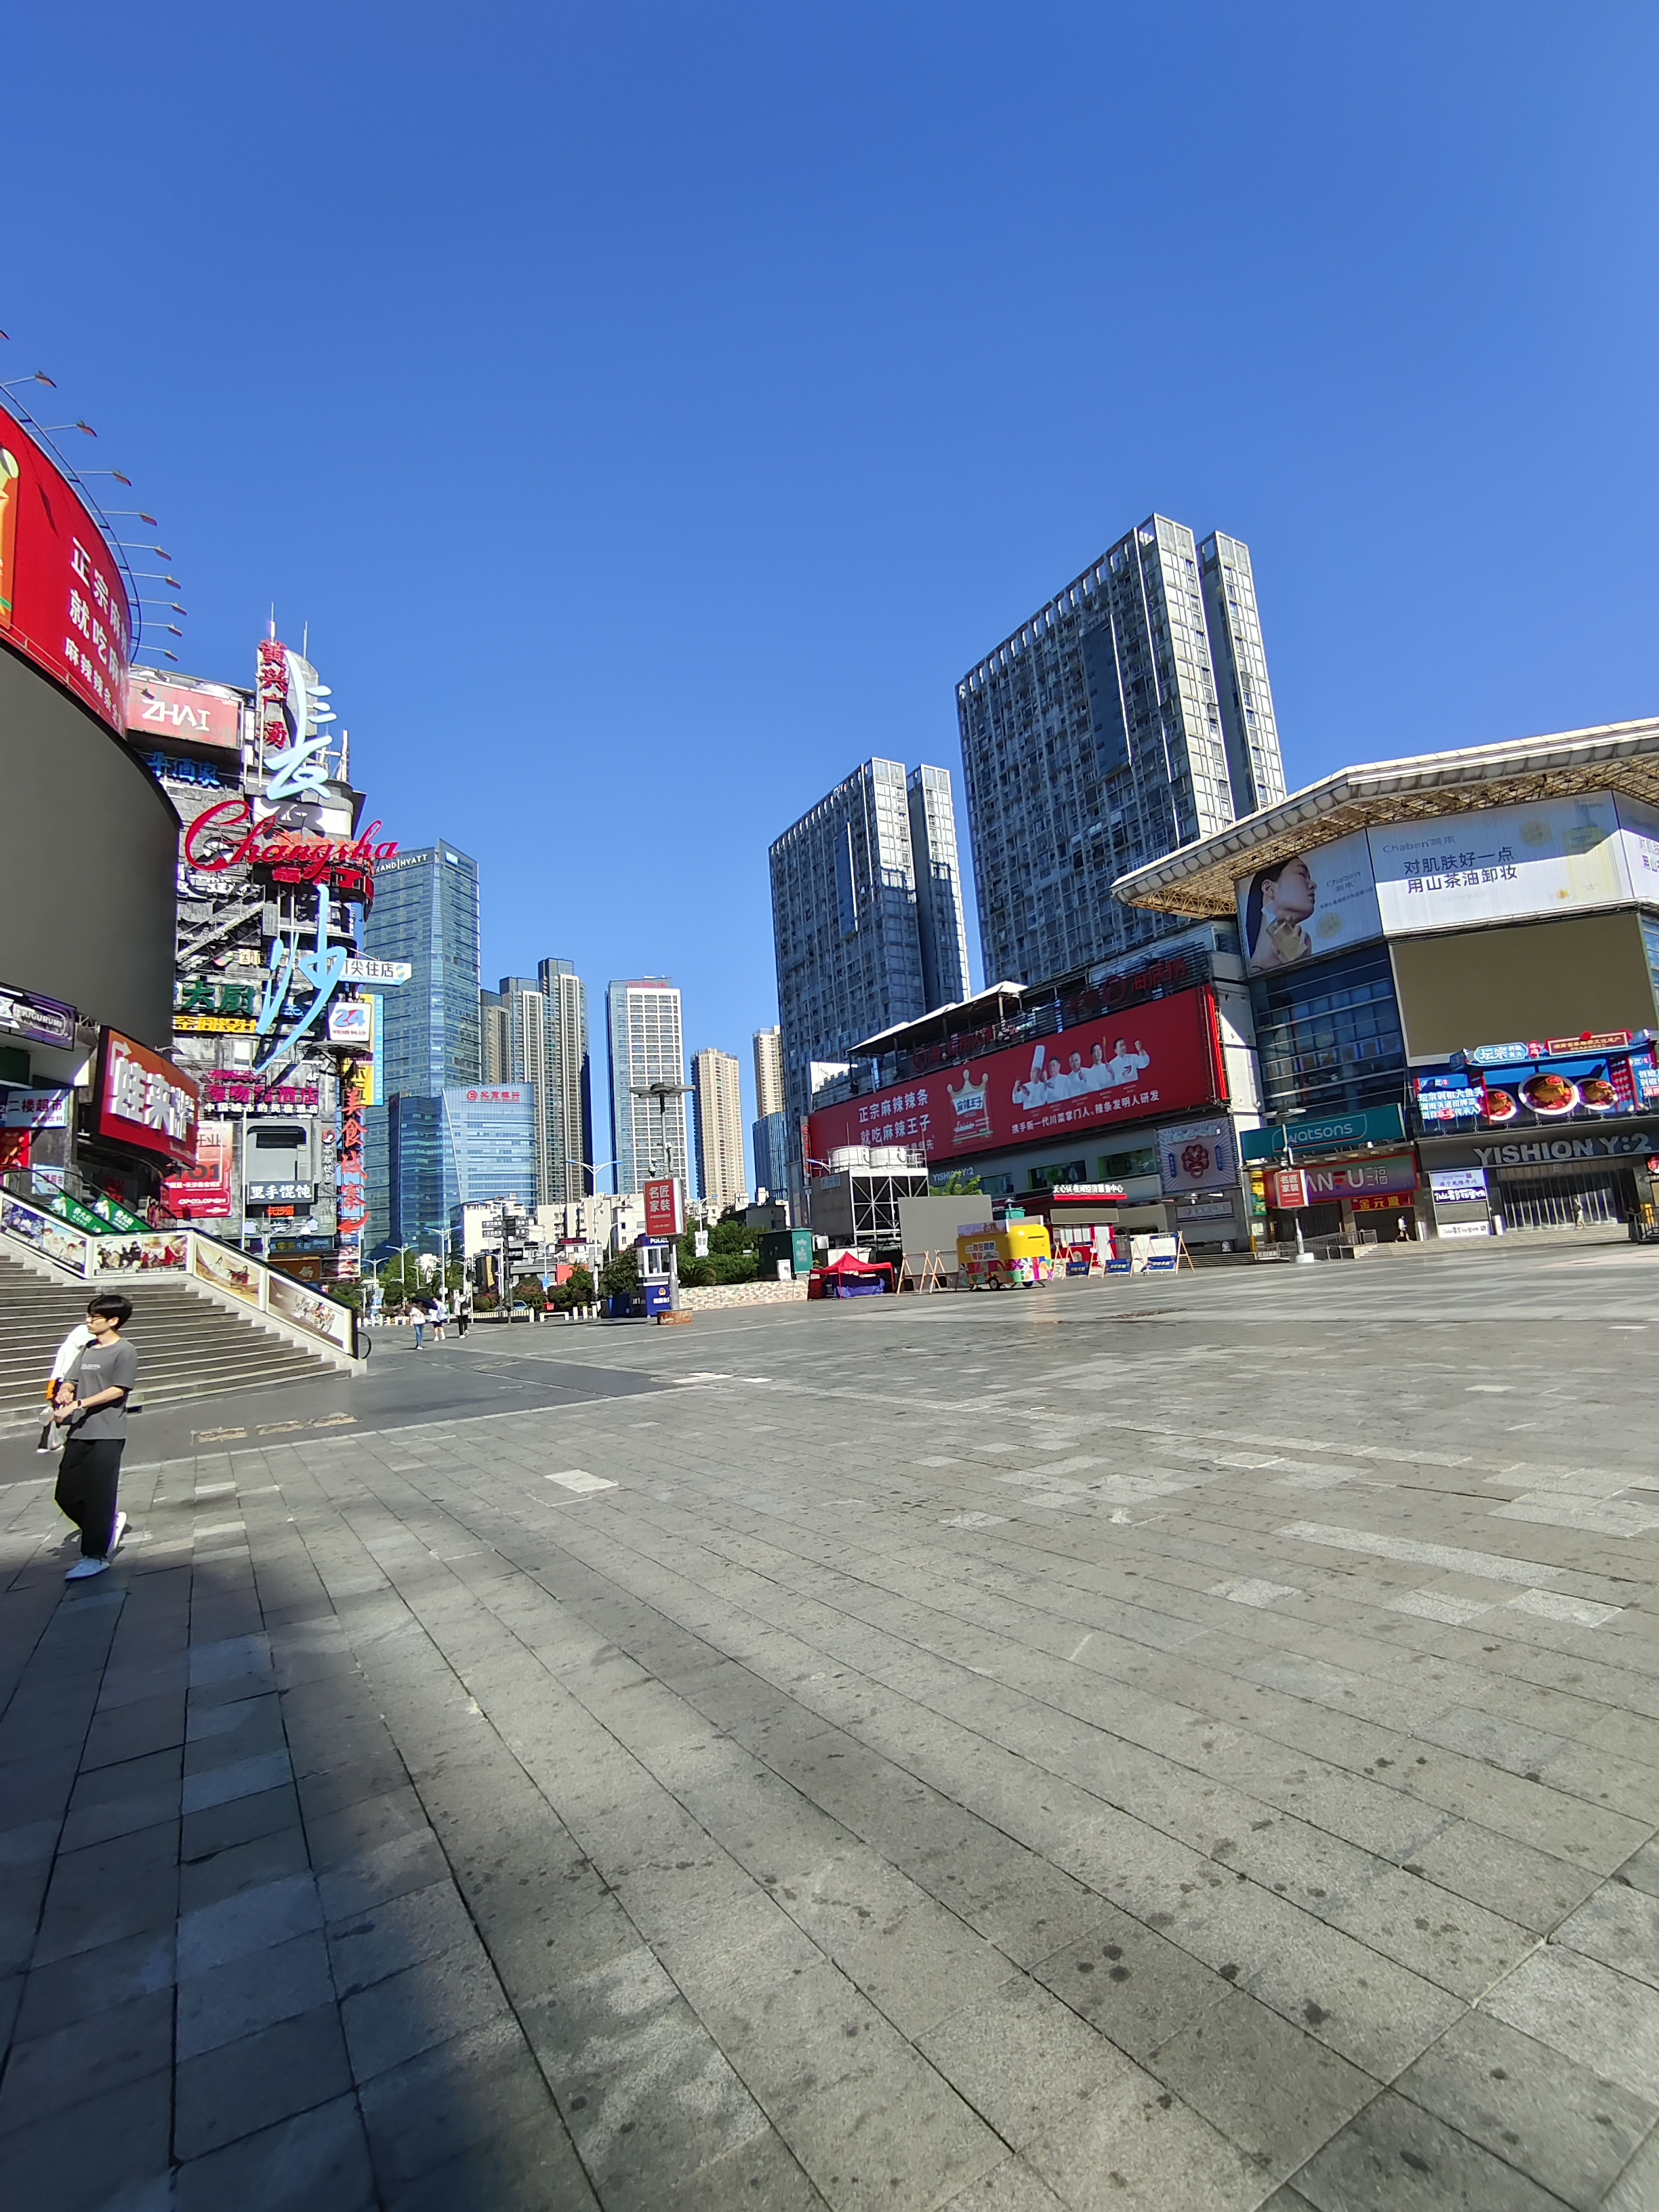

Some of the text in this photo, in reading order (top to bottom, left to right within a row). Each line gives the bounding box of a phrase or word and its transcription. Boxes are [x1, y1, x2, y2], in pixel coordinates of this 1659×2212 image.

[185, 800, 401, 880] Changsha
[375, 854, 428, 874] RAND HYATT
[1404, 846, 1515, 875] 对肌肤好一点
[1408, 865, 1518, 894] 用山茶油卸妆
[8, 1098, 62, 1113] 二楼超市
[859, 1088, 929, 1124] 正宗麻辣辣条
[860, 1113, 931, 1146] 就吃麻辣王子
[1473, 1132, 1652, 1166] YISHION Y:2
[649, 1185, 670, 1200] 名匠
